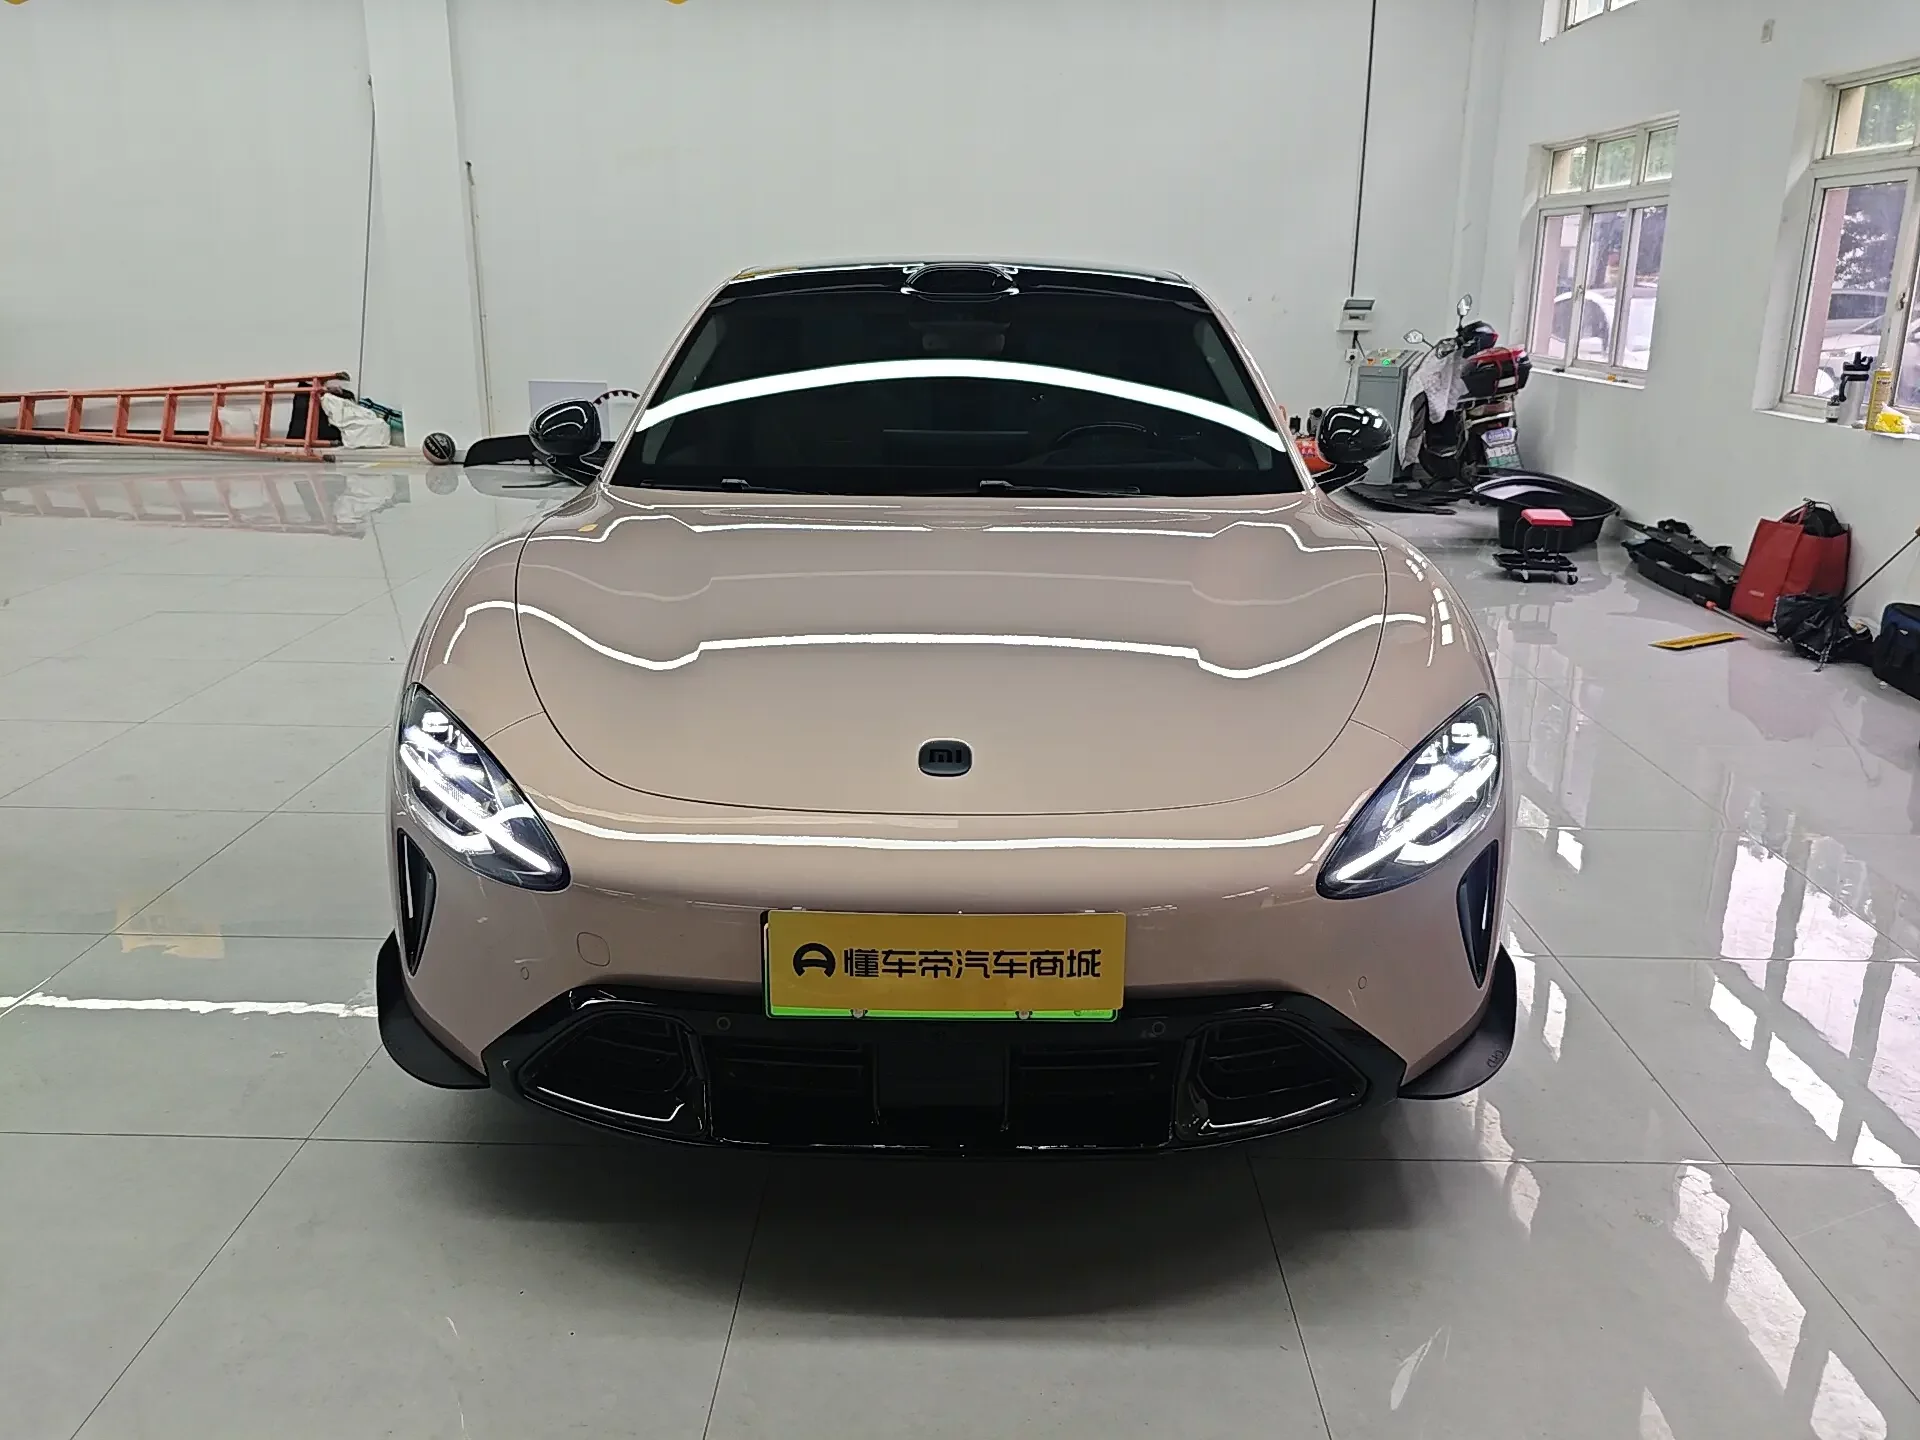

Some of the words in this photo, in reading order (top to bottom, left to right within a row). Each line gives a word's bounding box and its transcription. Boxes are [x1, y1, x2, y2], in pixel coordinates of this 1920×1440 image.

[843, 948, 1102, 979] 懂车帝汽车商城
